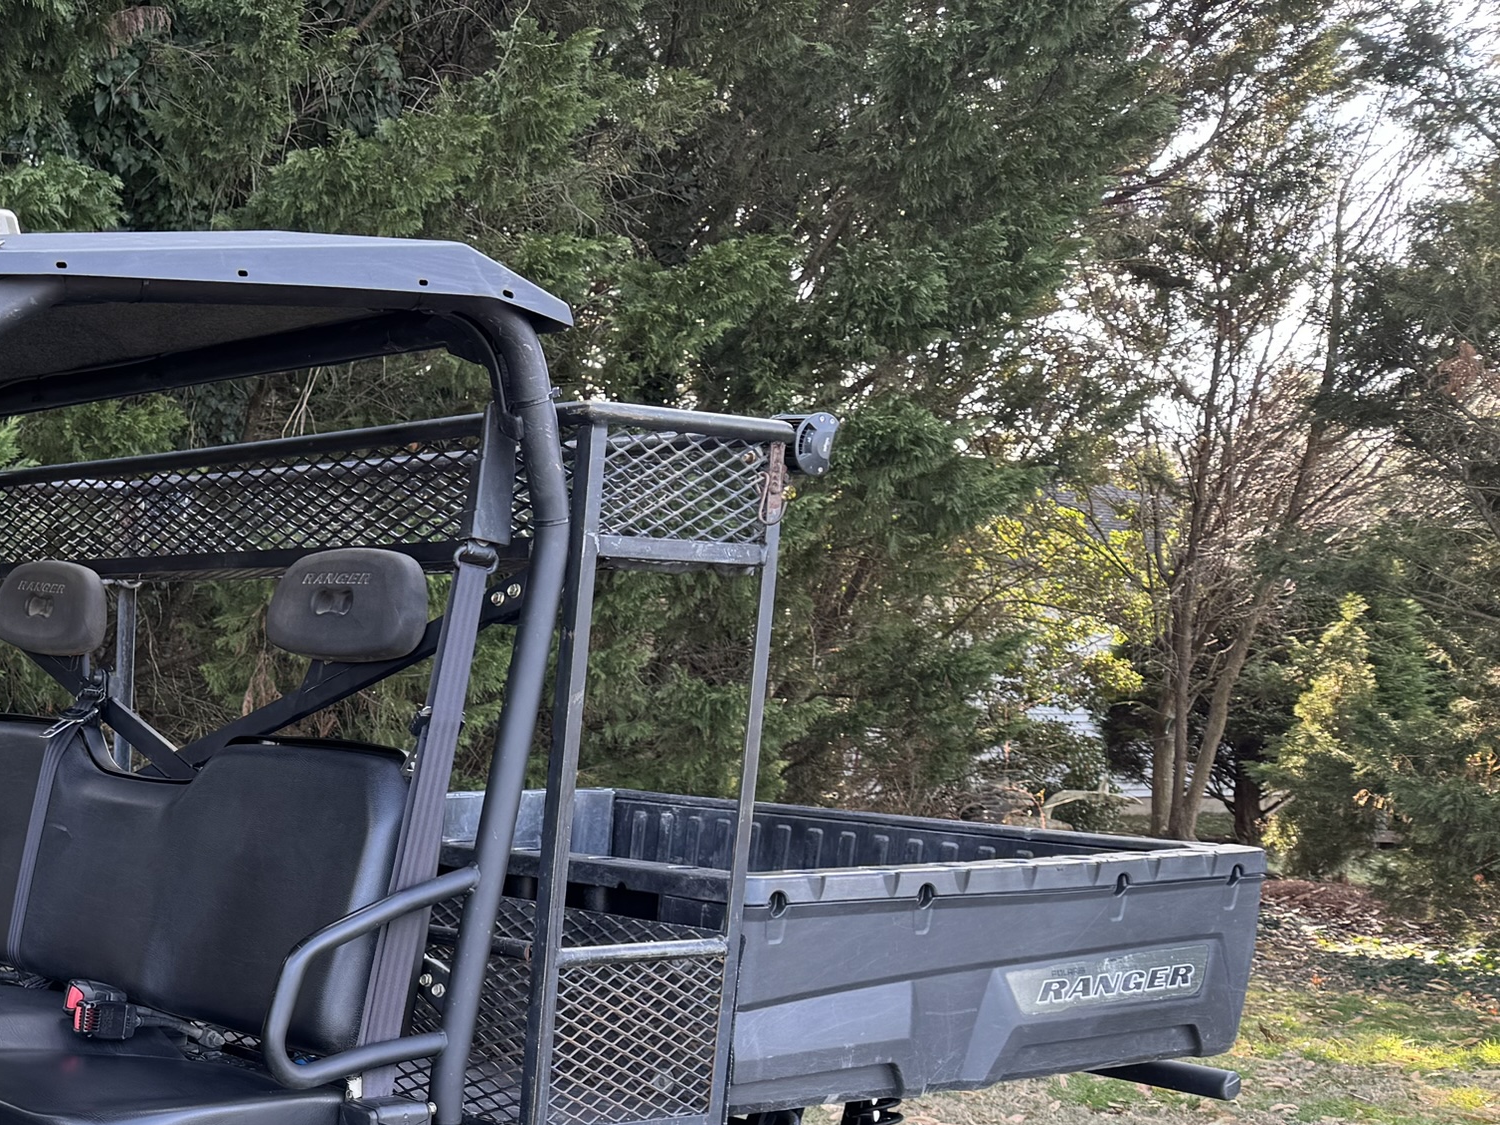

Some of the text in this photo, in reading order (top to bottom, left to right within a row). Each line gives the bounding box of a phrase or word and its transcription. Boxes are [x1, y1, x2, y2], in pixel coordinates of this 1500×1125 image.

[302, 572, 372, 585] RANGER
[17, 580, 66, 594] RANGER
[1036, 963, 1195, 1004] RANGER
